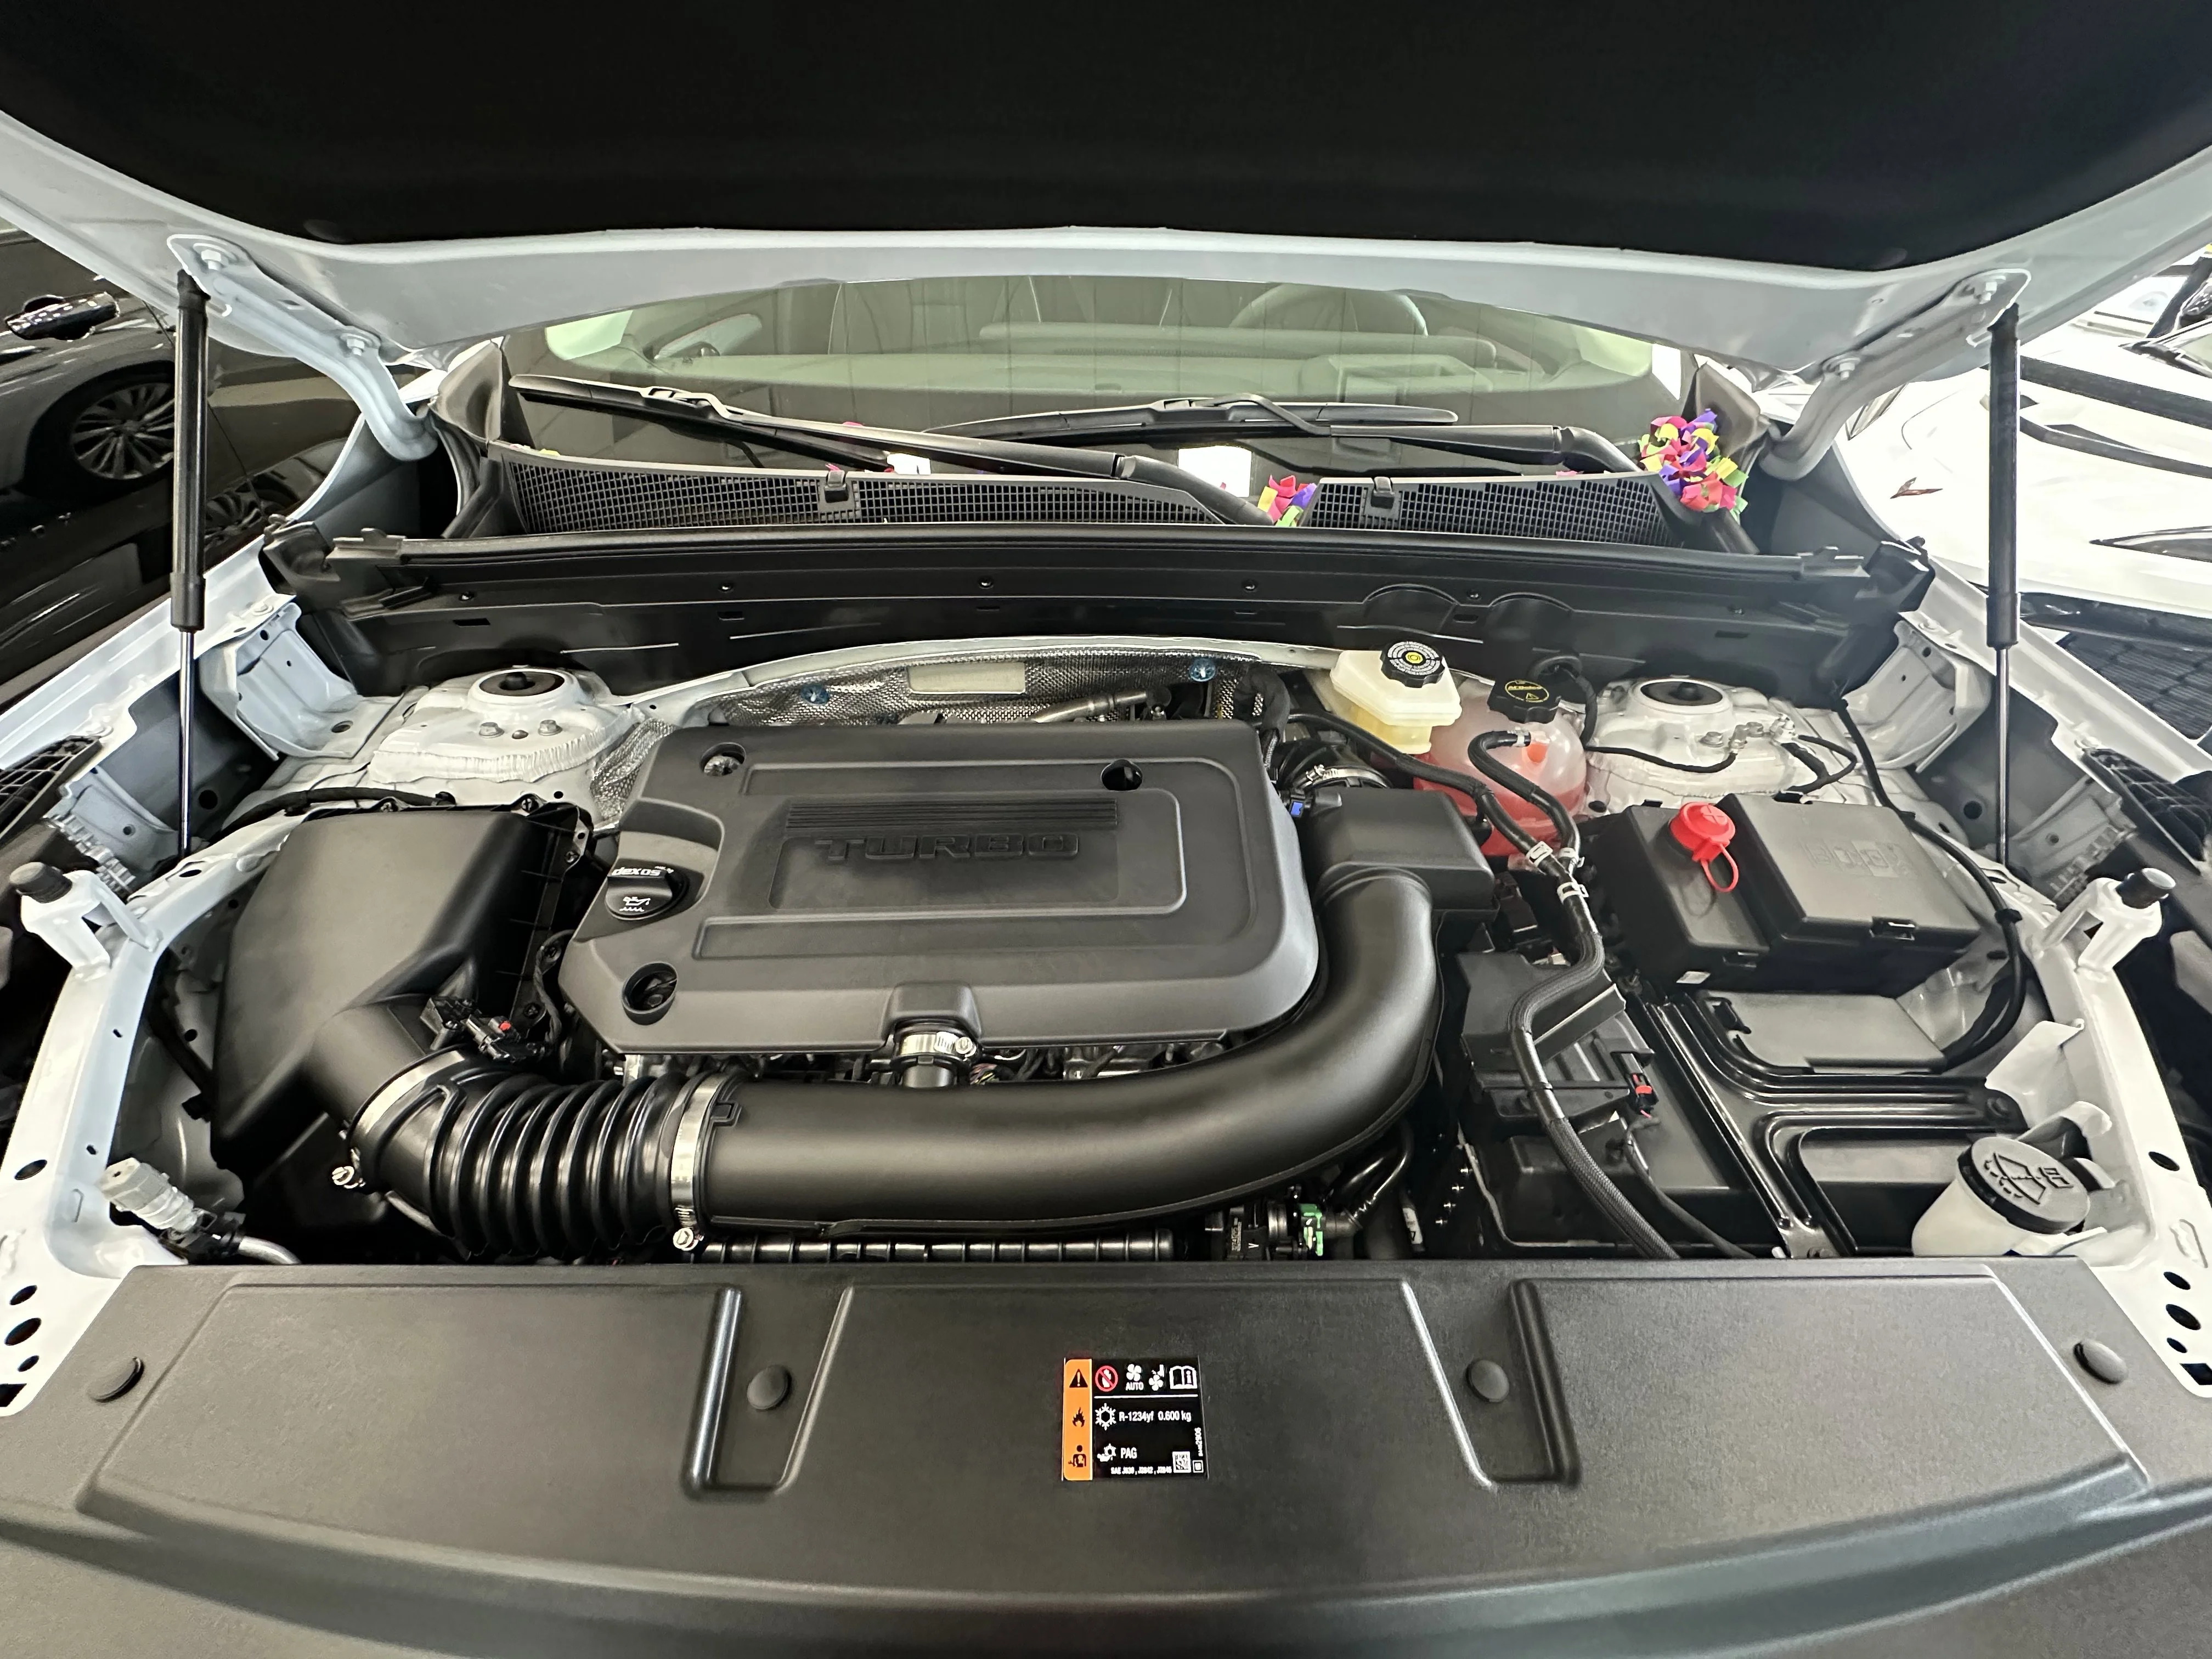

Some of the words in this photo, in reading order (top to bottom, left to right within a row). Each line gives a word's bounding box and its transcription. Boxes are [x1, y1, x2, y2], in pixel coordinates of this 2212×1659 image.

[815, 832, 1079, 861] TURBO
[612, 867, 662, 876] dexos
[1126, 1381, 1144, 1391] AUTO
[1119, 1410, 1154, 1423] R-1234yf
[1158, 1410, 1180, 1421] 0.600
[1181, 1410, 1192, 1423] kg
[1120, 1447, 1137, 1459] PAG
